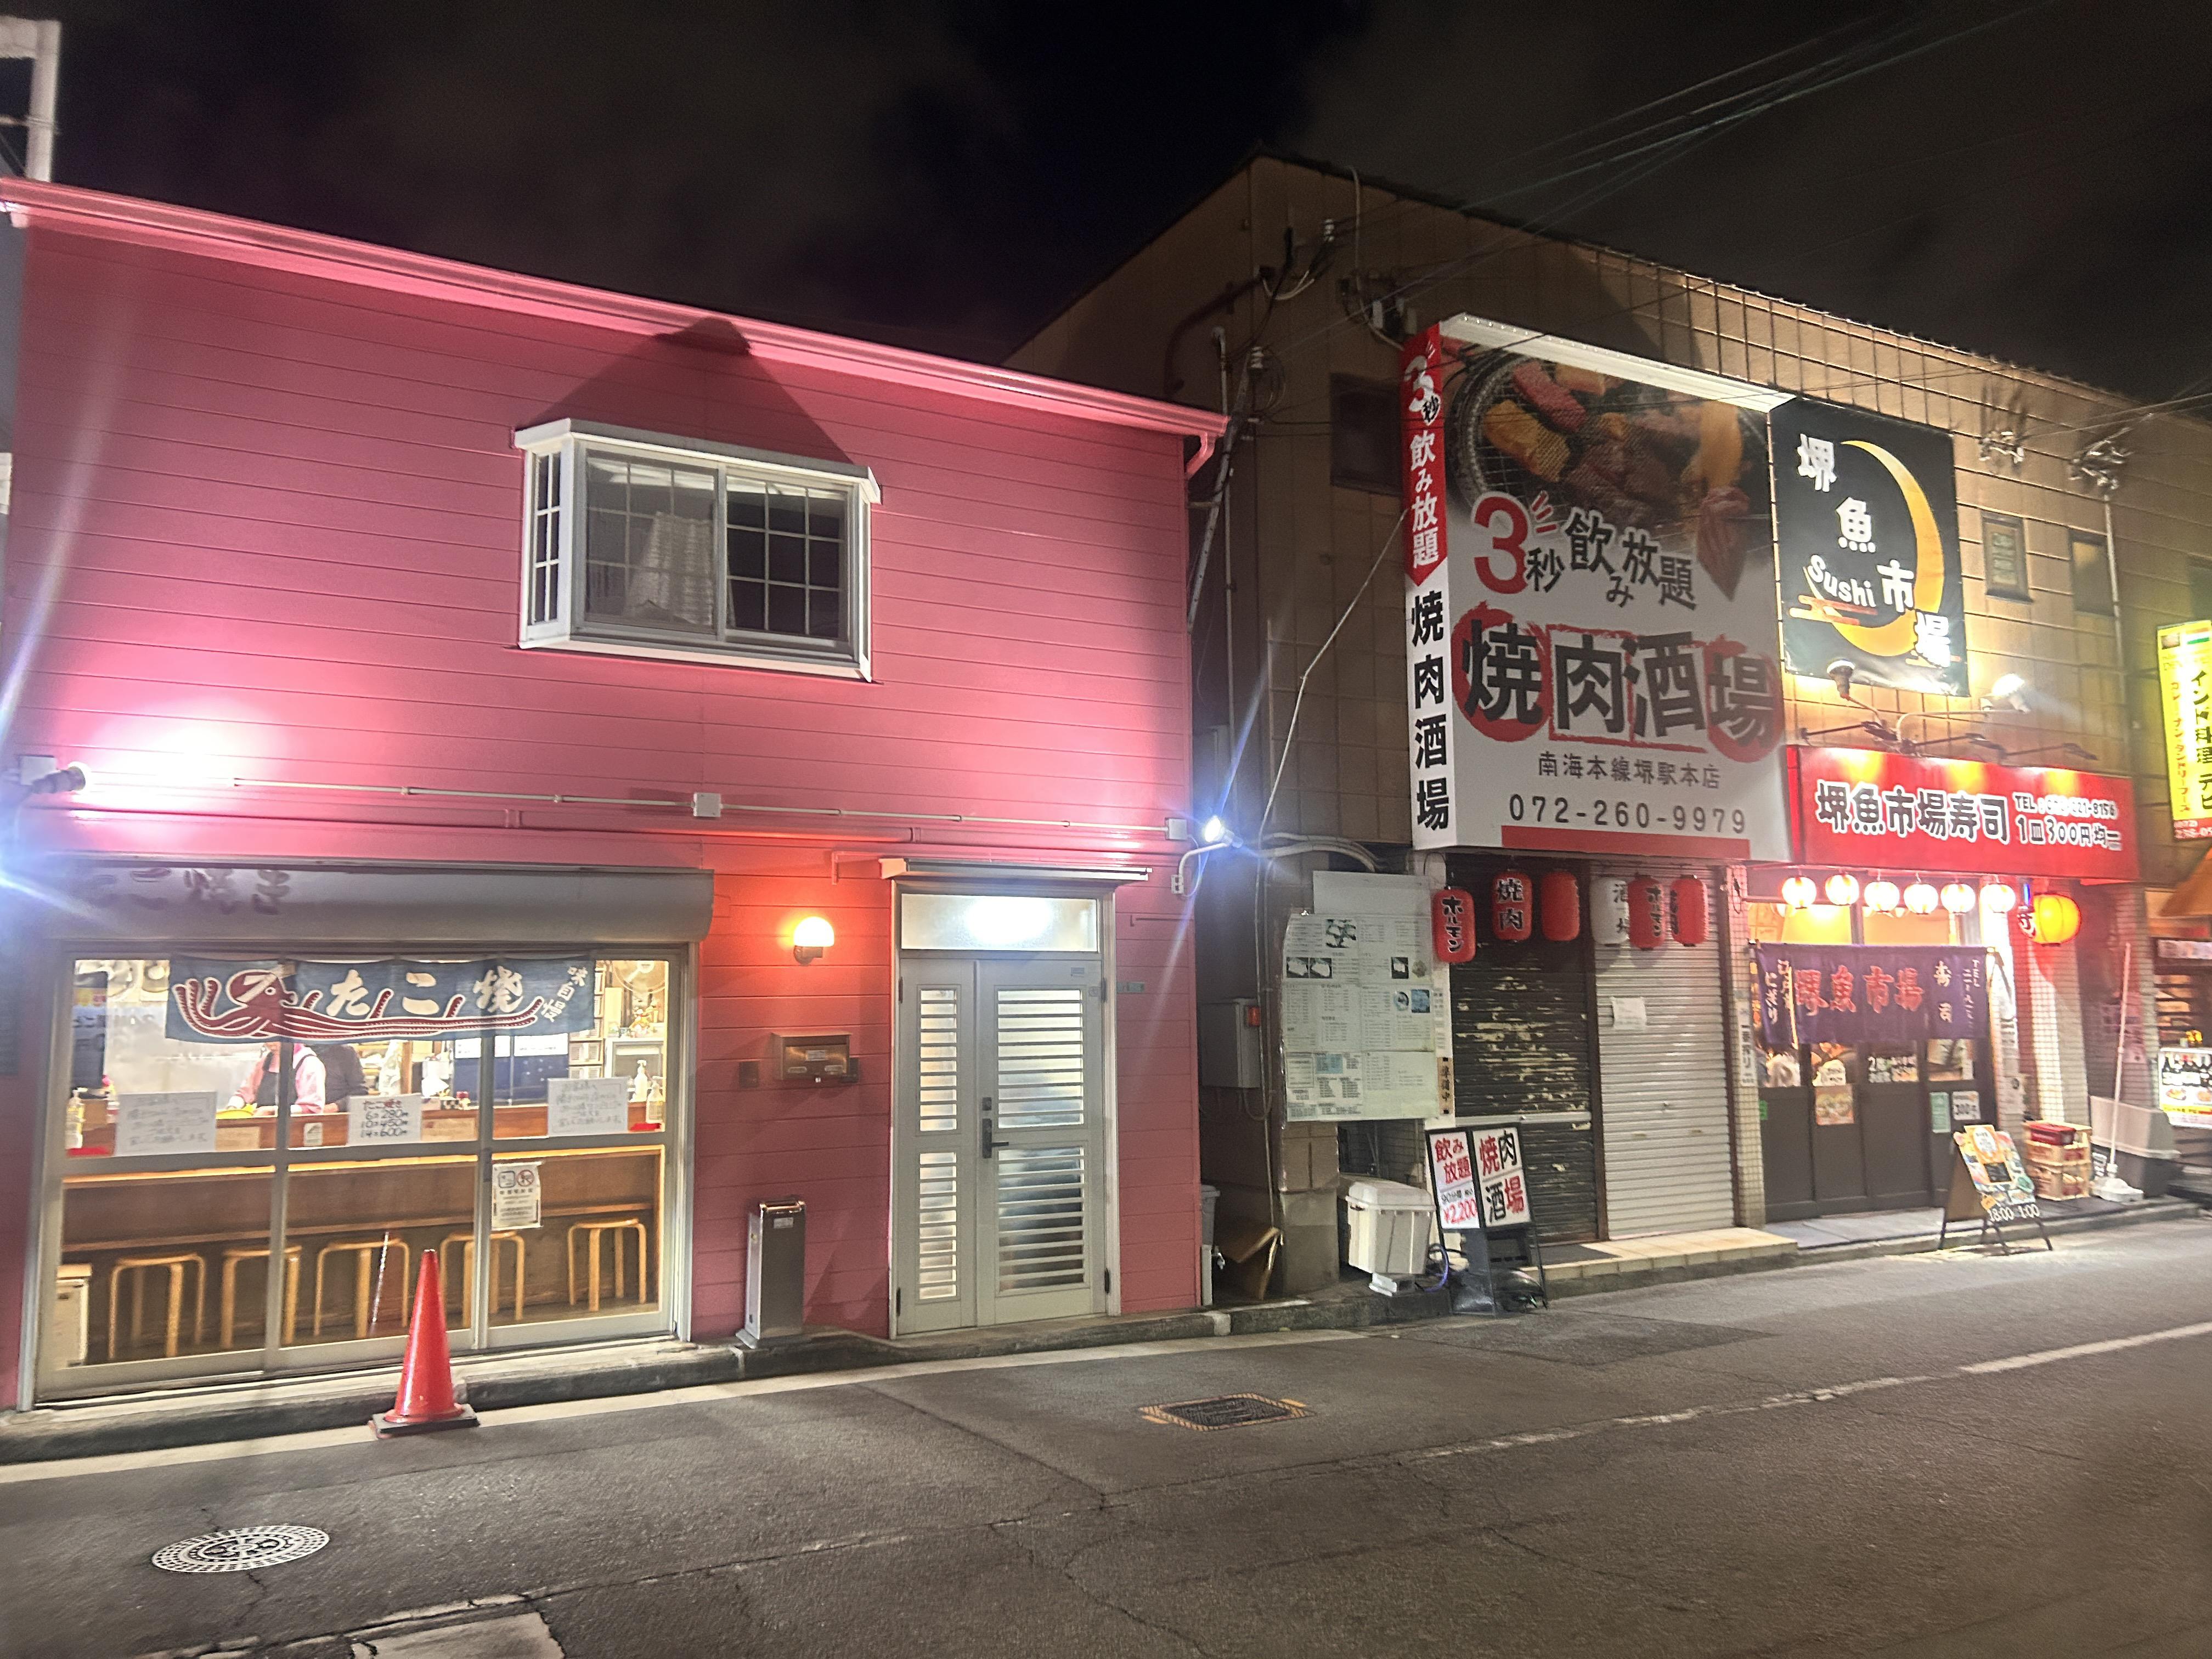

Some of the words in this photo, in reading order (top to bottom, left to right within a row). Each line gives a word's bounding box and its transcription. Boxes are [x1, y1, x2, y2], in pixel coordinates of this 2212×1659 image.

[1404, 355, 1441, 569] 3秒飲み放題
[1474, 496, 1696, 611] 3秒飲み放題
[1809, 554, 1876, 607] Sushi
[1412, 590, 1449, 831] 焼肉酒場
[1462, 619, 1774, 748] 焼肉酒場
[1538, 751, 1720, 789] 南海本線堺駅本店
[1509, 794, 1746, 834] 072-260-9979
[1816, 780, 2009, 845] 堺魚市場寿司
[1441, 895, 1465, 953] ホルモン
[1496, 878, 1524, 932] 焼肉
[543, 967, 589, 1023] 味自慢
[1795, 964, 1924, 1016] 堺魚市場
[1933, 960, 1953, 1024] 寿司
[1435, 1137, 1464, 1163] 飲み
[1443, 1156, 1472, 1184] 放題
[1480, 1129, 1517, 1176] 焼肉
[1486, 1176, 1525, 1223] 酒場
